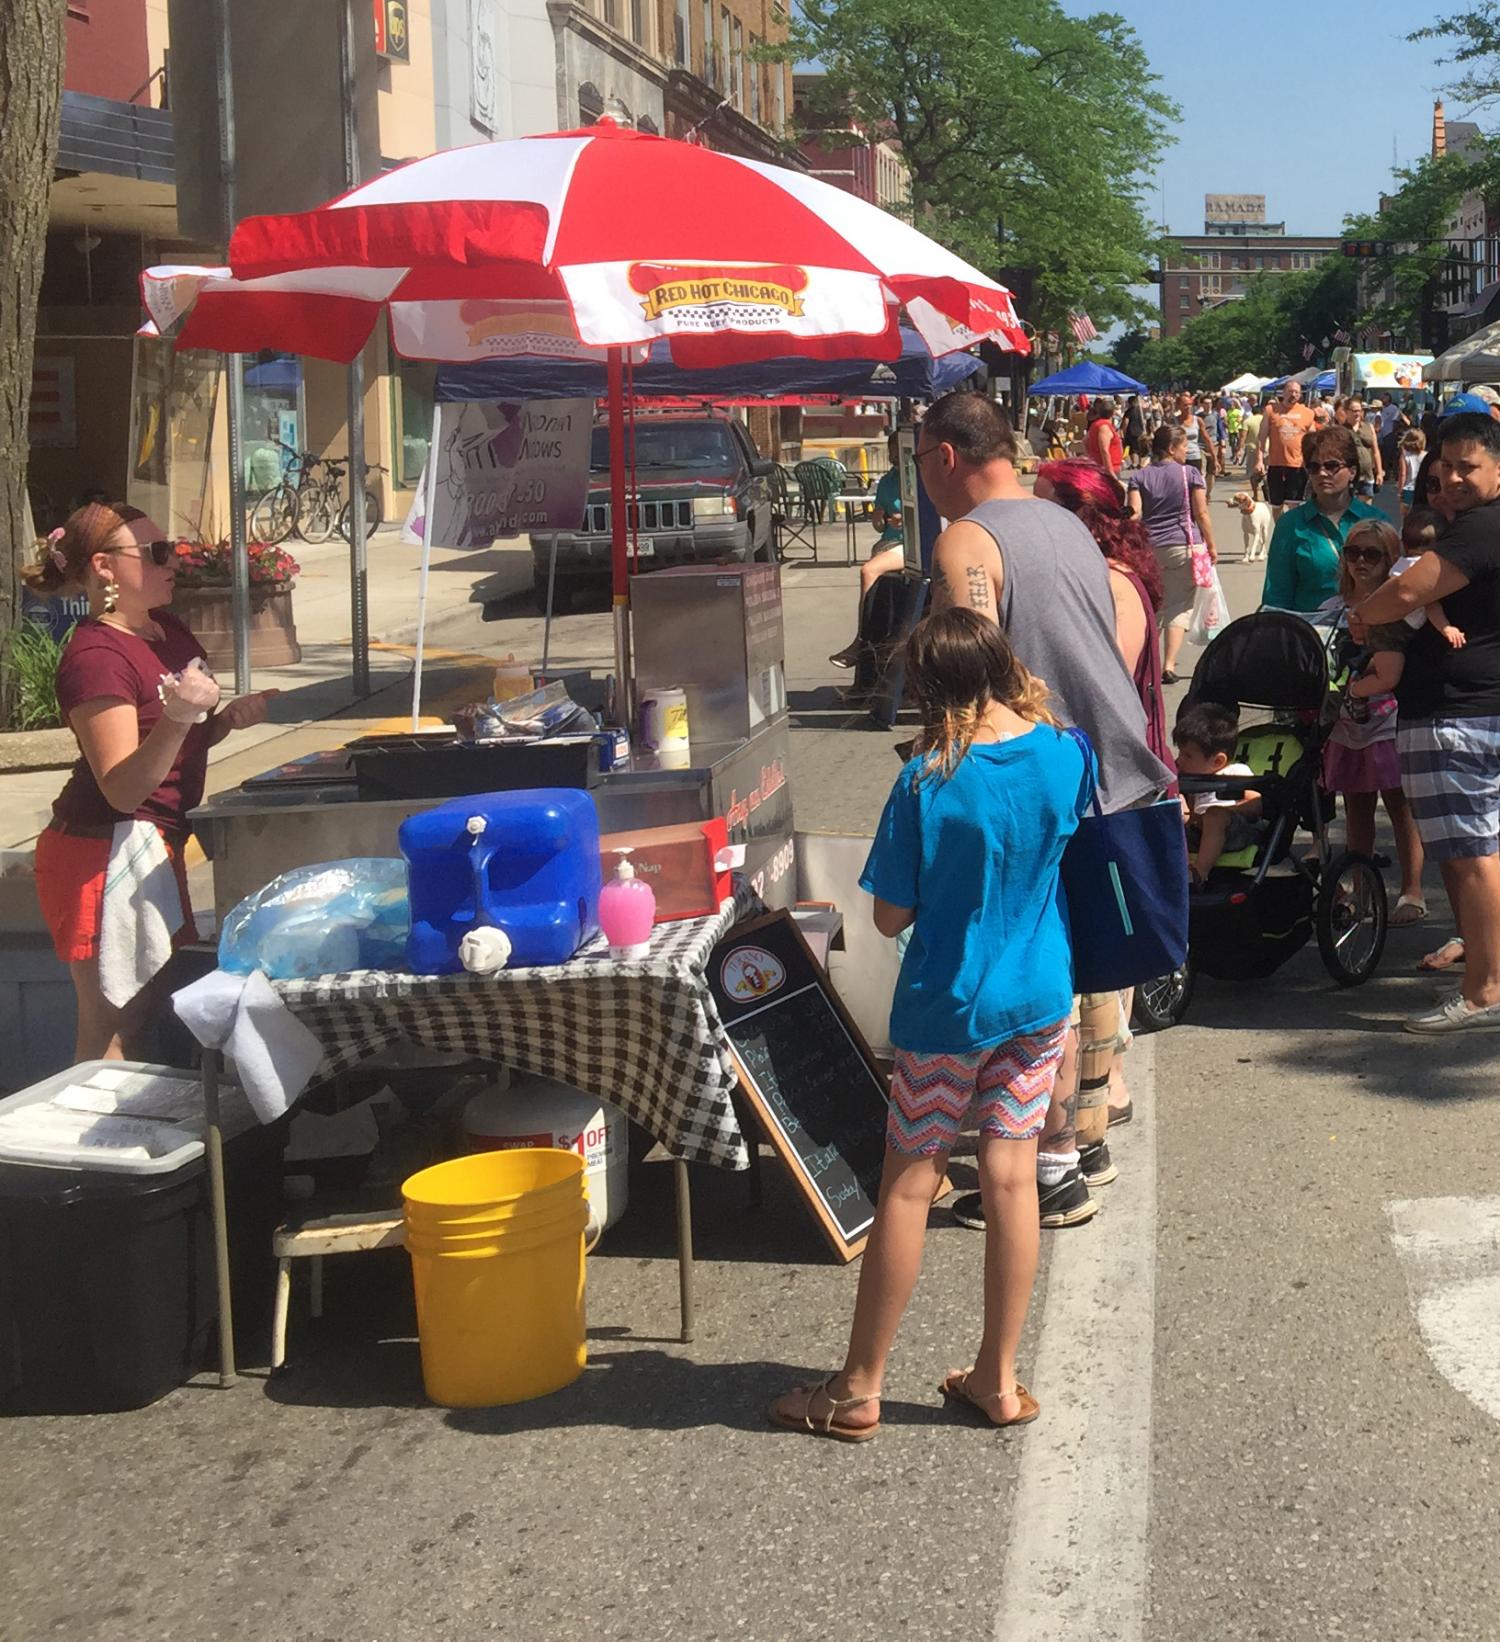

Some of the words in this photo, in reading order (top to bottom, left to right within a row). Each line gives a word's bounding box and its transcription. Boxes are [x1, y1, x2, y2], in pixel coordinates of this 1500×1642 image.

[655, 286, 687, 306] RED
[690, 283, 721, 299] HOT
[723, 281, 789, 305] CHICAGO
[730, 317, 780, 326] PRODUCTS
[587, 1125, 612, 1147] OFF
